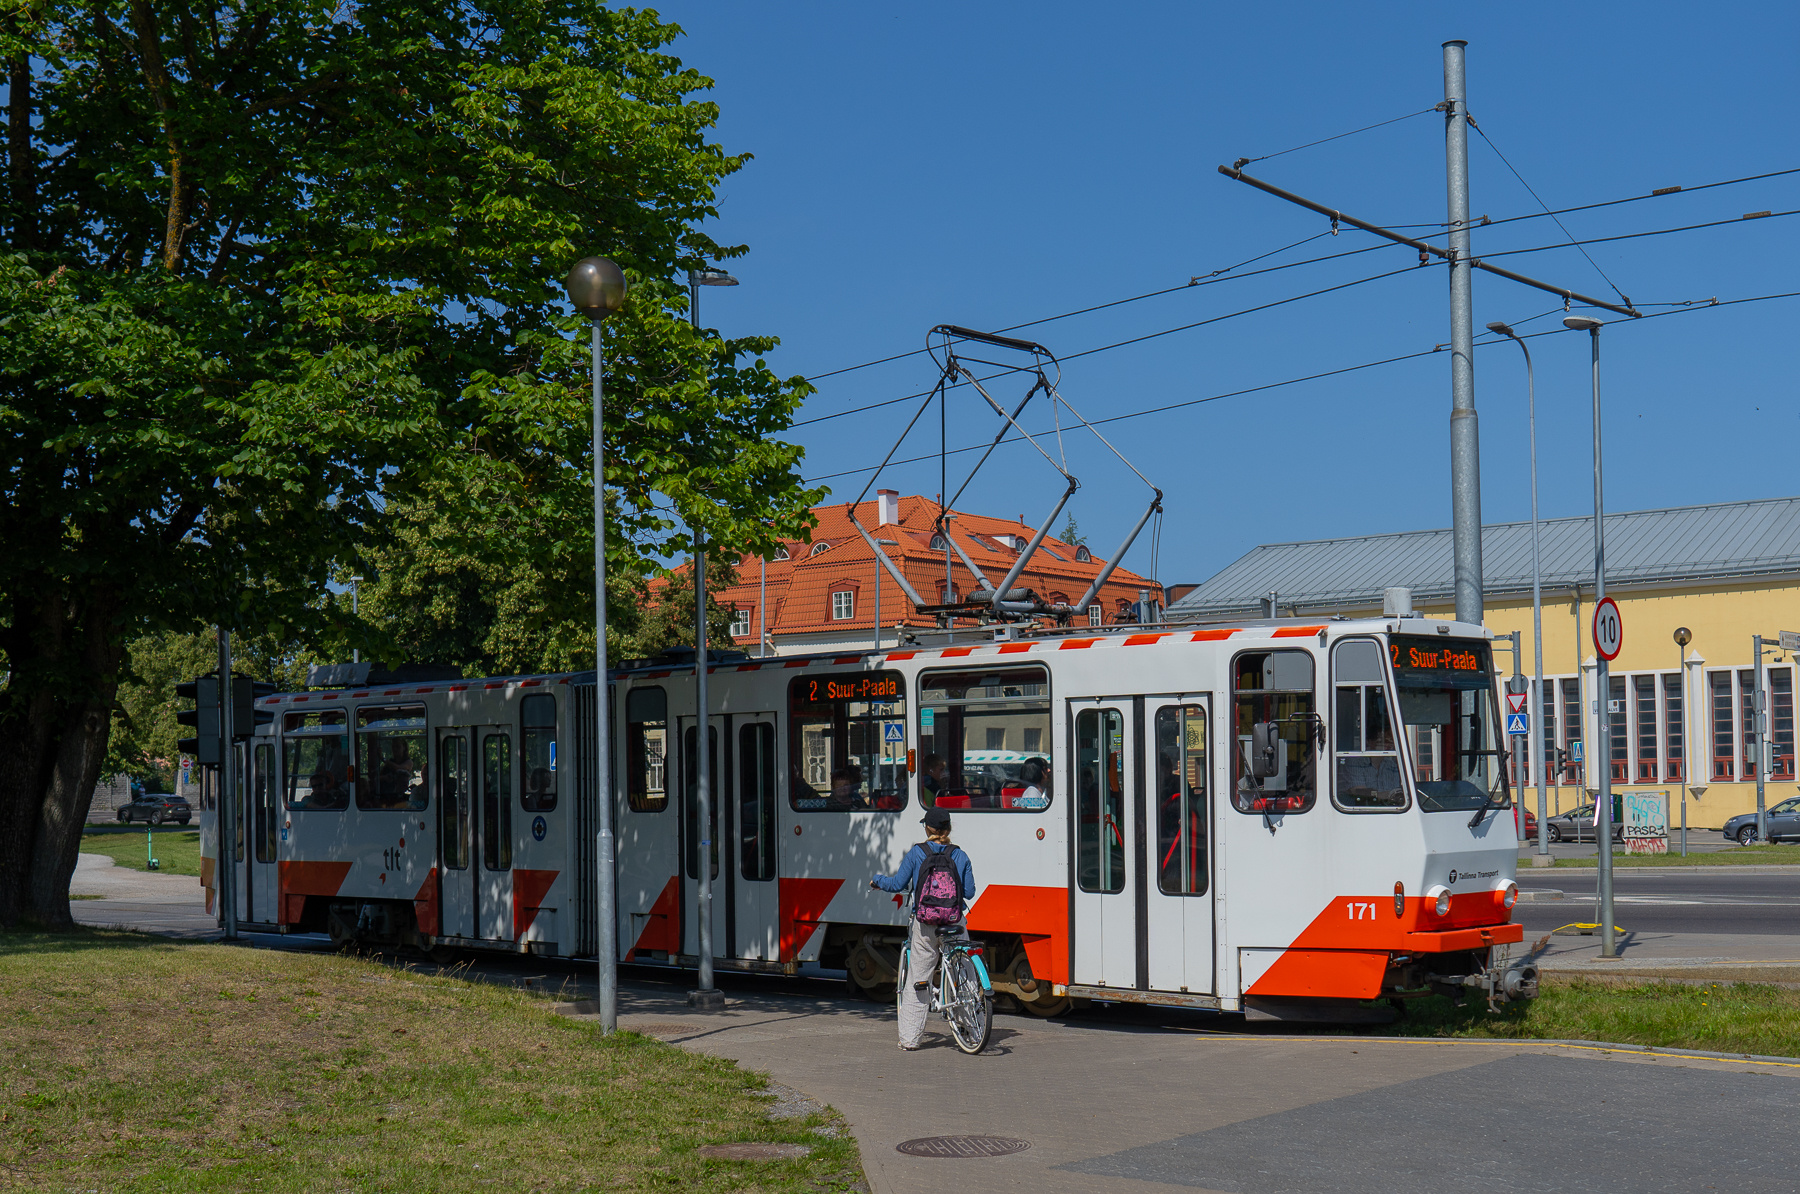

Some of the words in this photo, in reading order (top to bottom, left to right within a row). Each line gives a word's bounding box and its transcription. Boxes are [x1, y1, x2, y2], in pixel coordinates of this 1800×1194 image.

[1601, 615, 1616, 644] 10
[1390, 645, 1401, 668] 2
[1409, 647, 1477, 670] Suur-Paala
[810, 680, 818, 701] 2
[828, 678, 896, 699] Suur-Paala
[383, 846, 401, 871] tlt
[1459, 872, 1477, 880] Tallinna
[1478, 870, 1499, 879] Transport
[1346, 902, 1376, 920] 171
